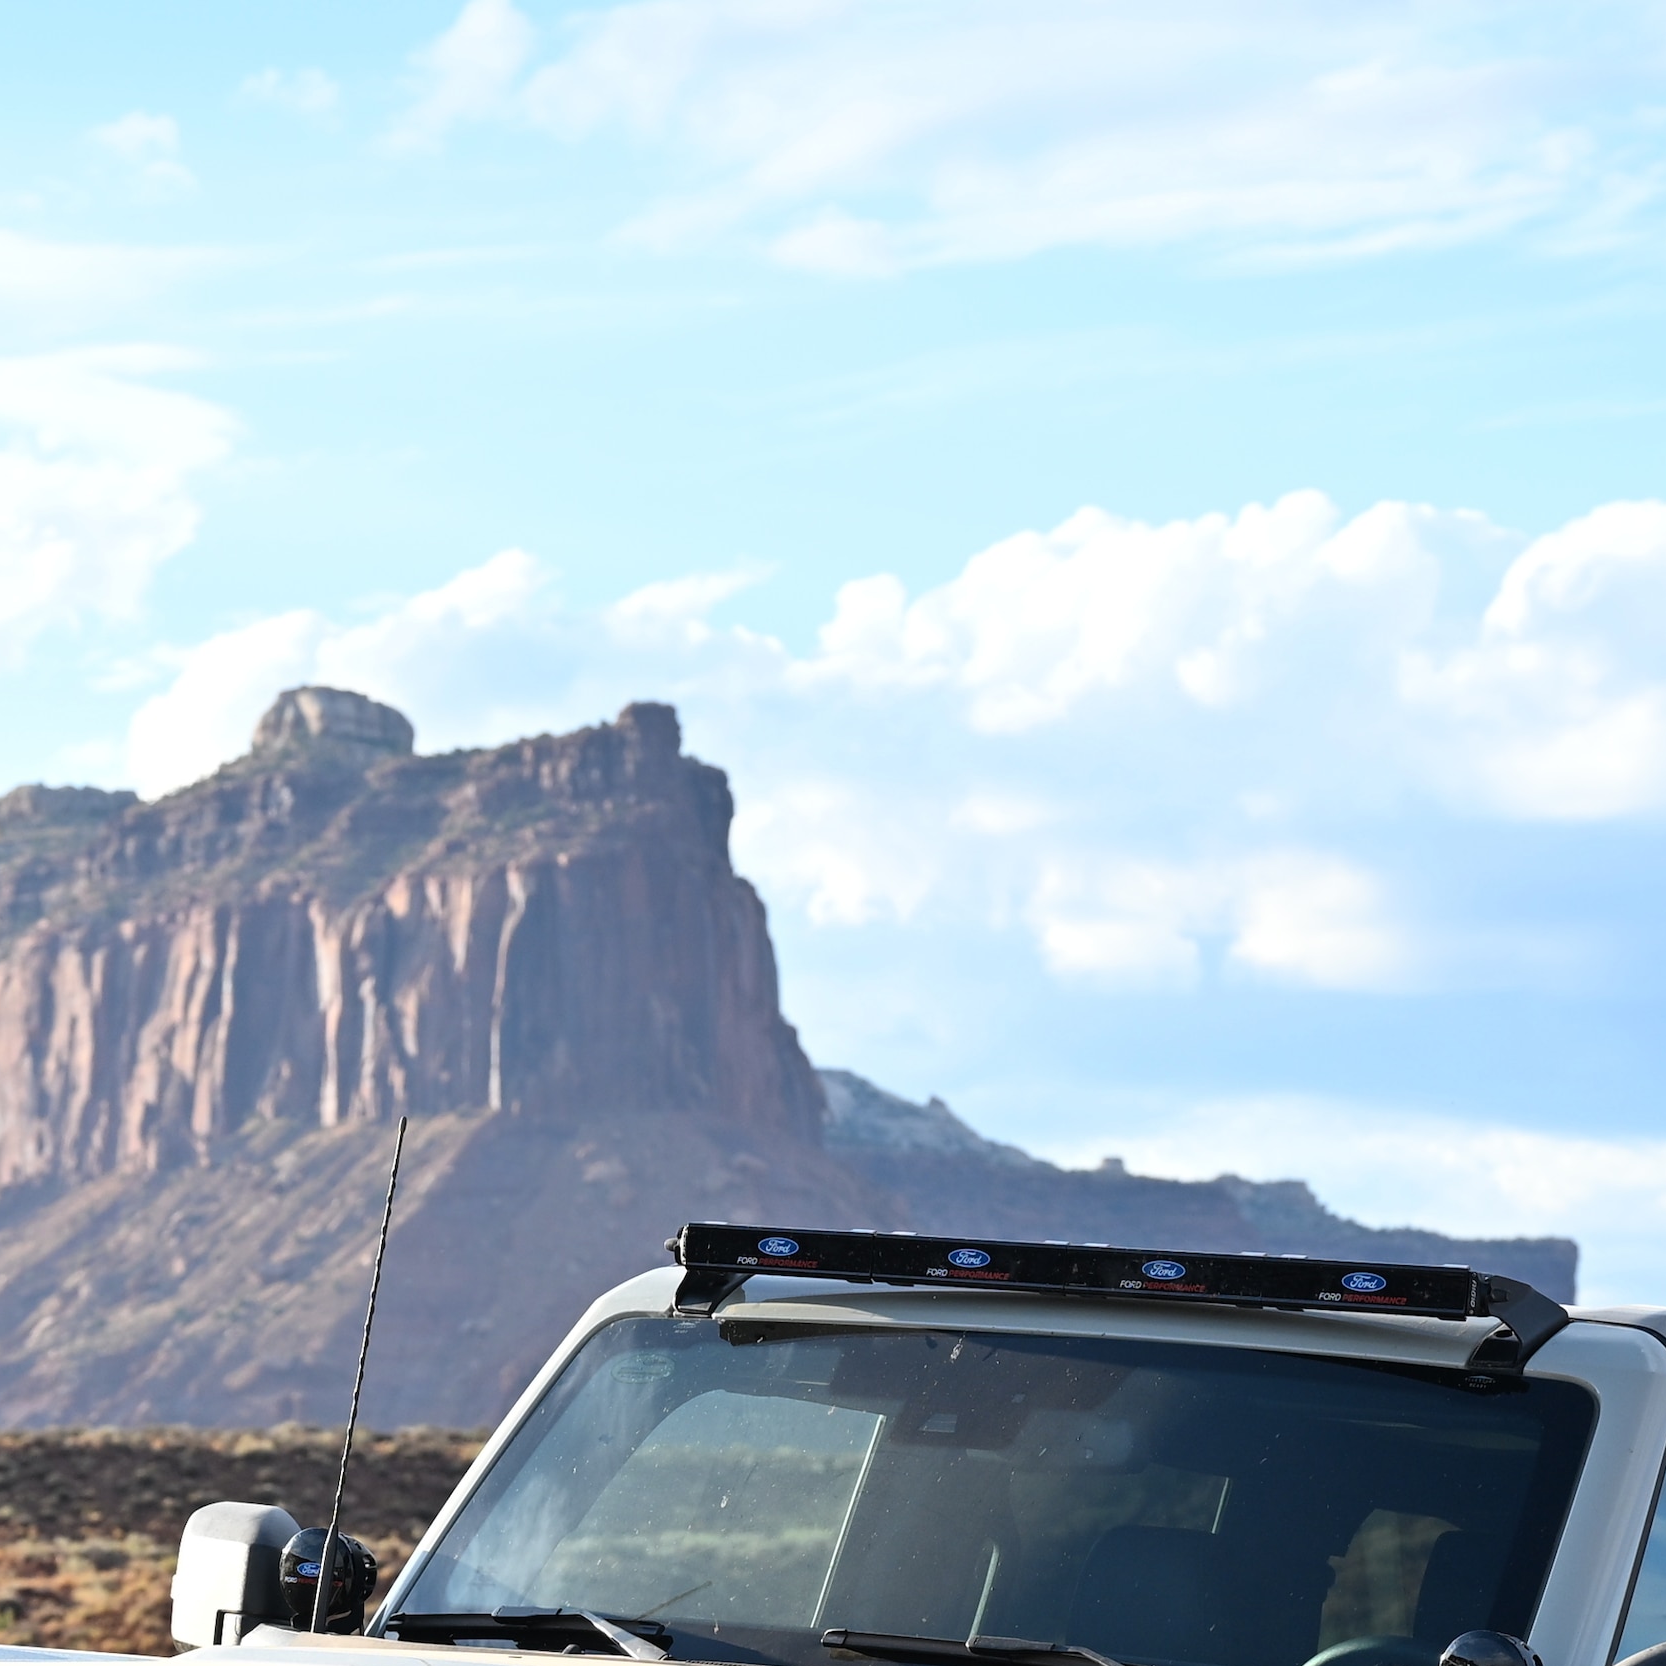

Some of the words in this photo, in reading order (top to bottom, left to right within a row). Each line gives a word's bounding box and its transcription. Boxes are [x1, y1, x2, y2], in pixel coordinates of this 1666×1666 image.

[764, 1238, 793, 1254] Ford
[736, 1256, 758, 1266] FORD
[758, 1258, 818, 1269] PERFORMANCE
[954, 1250, 983, 1266] Ford
[925, 1267, 948, 1278] FORD
[948, 1270, 1010, 1280] PERFORMANCE
[1148, 1262, 1179, 1278] Ford
[1119, 1279, 1142, 1290] FORD
[1143, 1282, 1206, 1292] PERFORMANCE
[1348, 1274, 1380, 1290] Ford
[1318, 1292, 1342, 1302] FORD
[1342, 1294, 1407, 1306] PERFORMANCE
